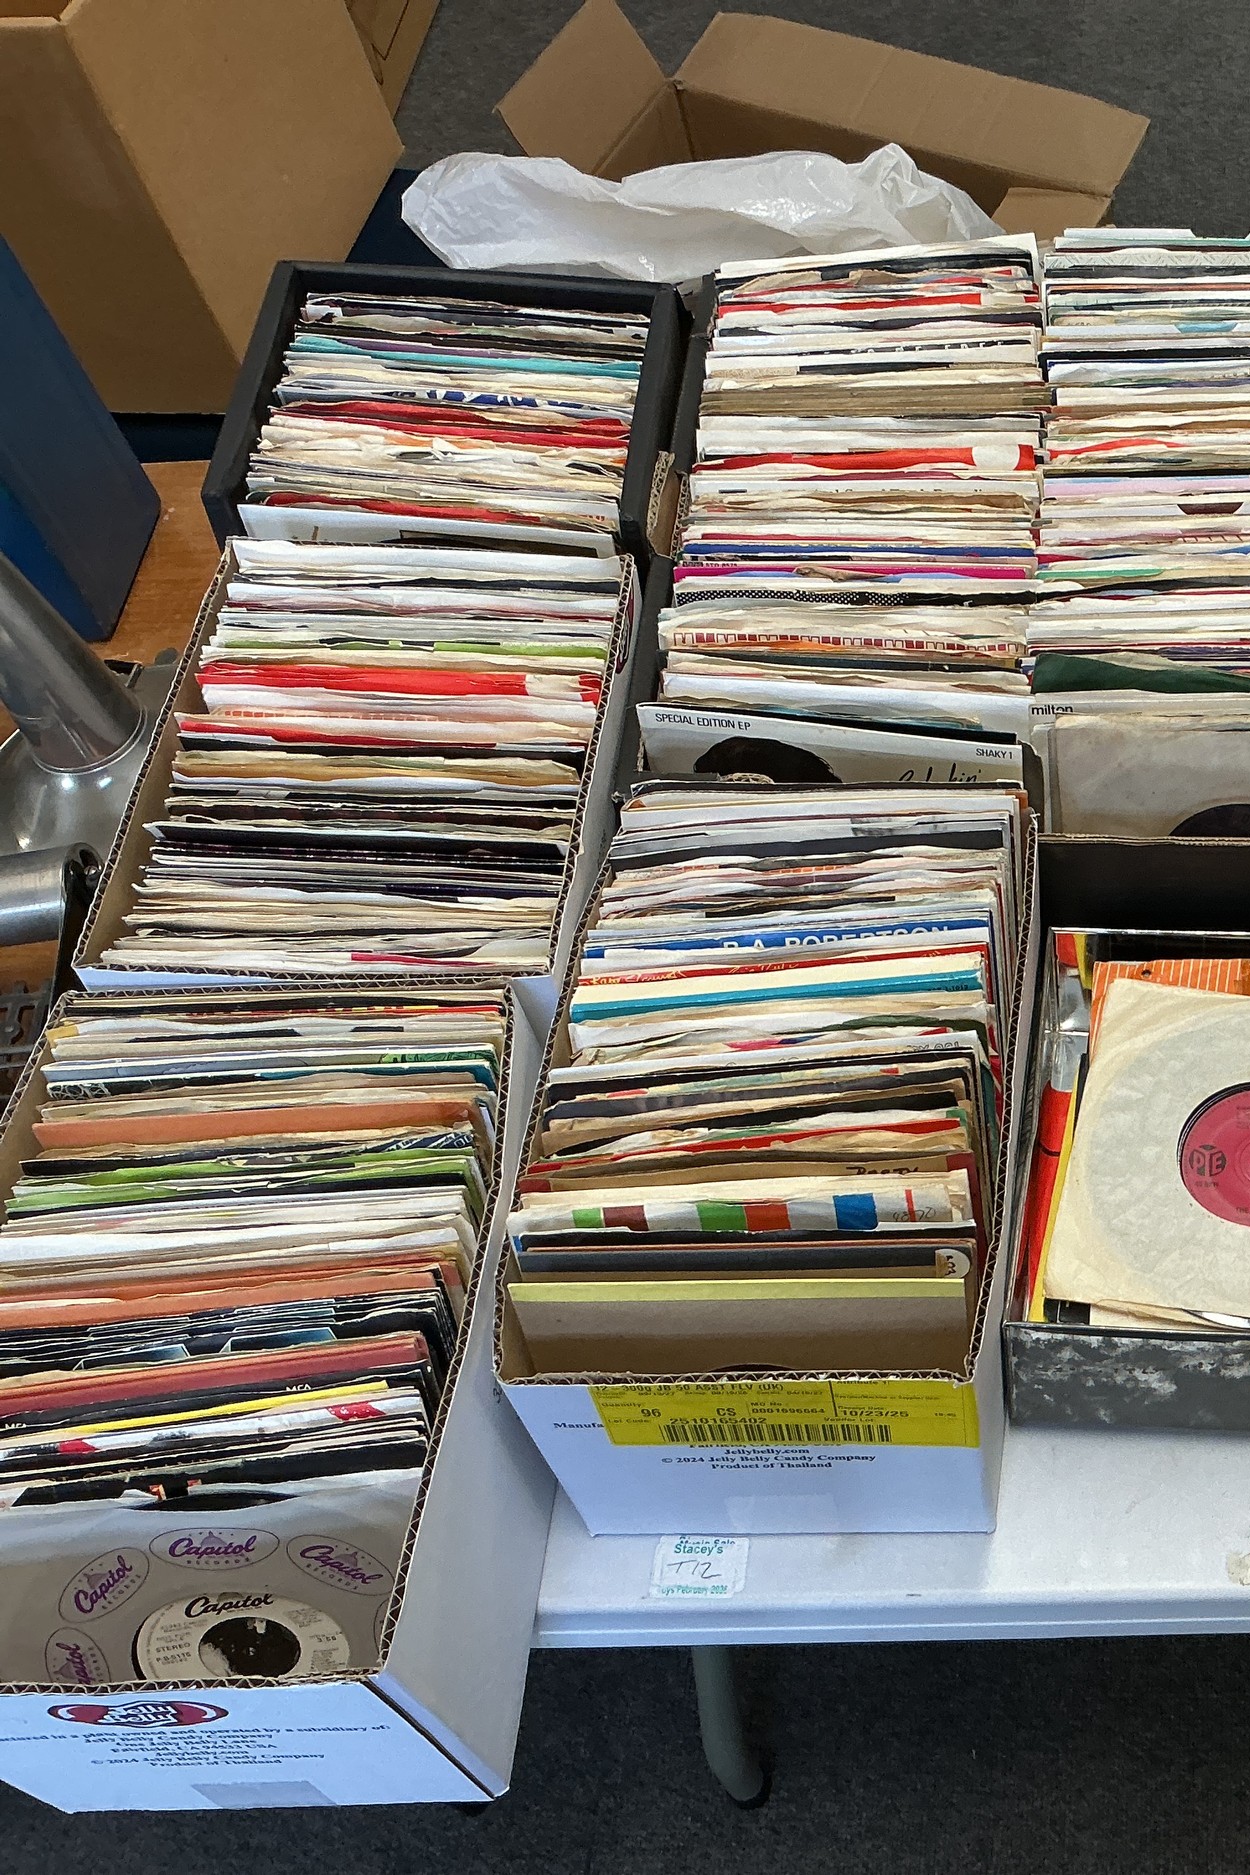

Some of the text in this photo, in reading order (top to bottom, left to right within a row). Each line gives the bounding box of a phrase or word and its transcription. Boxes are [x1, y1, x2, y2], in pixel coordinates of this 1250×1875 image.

[654, 712, 751, 731] SPECIAL EDITION EP
[975, 747, 1006, 760] SHAKY
[1189, 1145, 1227, 1177] PYE
[731, 1383, 753, 1391] FLV
[758, 1383, 784, 1391] (UK)
[640, 1407, 737, 1418] 96 CS
[841, 1410, 909, 1418] 10/23/25
[724, 1448, 810, 1456] Jellybelly.com
[739, 1455, 771, 1463] Belly
[773, 1454, 815, 1462] Candy
[817, 1454, 876, 1462] Company
[777, 1461, 833, 1469] Thailand
[168, 1534, 258, 1559] Capitol
[673, 1543, 724, 1556] Stacey's
[299, 1544, 384, 1585] Capitol
[73, 1554, 133, 1615] Capitol
[184, 1593, 275, 1619] Capitol
[155, 1642, 191, 1654] STEREO
[107, 1705, 178, 1715] Jelly
[97, 1713, 178, 1724] Belly
[82, 1732, 118, 1740] plant
[84, 1736, 116, 1744] Jelly
[157, 1734, 203, 1743] Candy
[206, 1733, 273, 1741] Company
